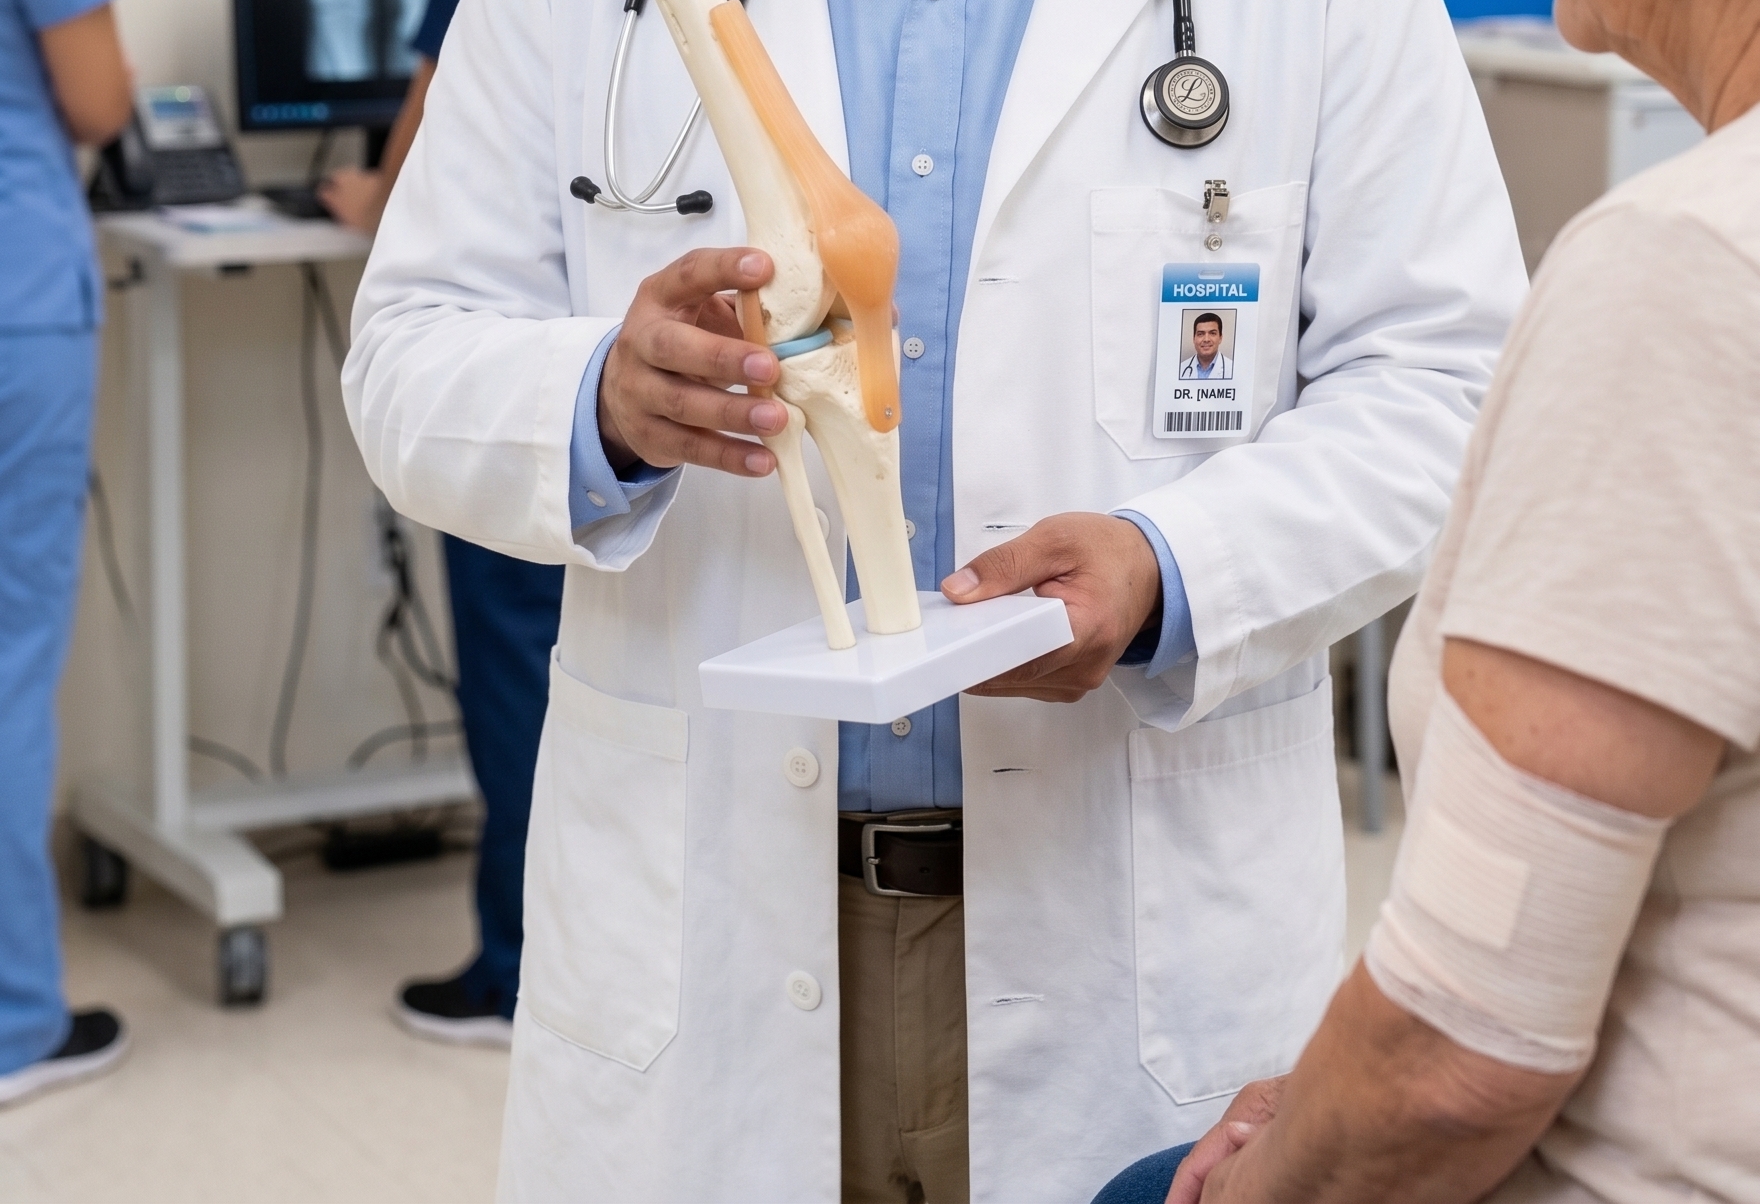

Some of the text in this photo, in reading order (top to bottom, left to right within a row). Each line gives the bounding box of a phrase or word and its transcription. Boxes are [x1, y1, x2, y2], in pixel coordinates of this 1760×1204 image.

[1173, 283, 1247, 297] HOSPITAL
[1174, 387, 1236, 401] DR. [NAME]
